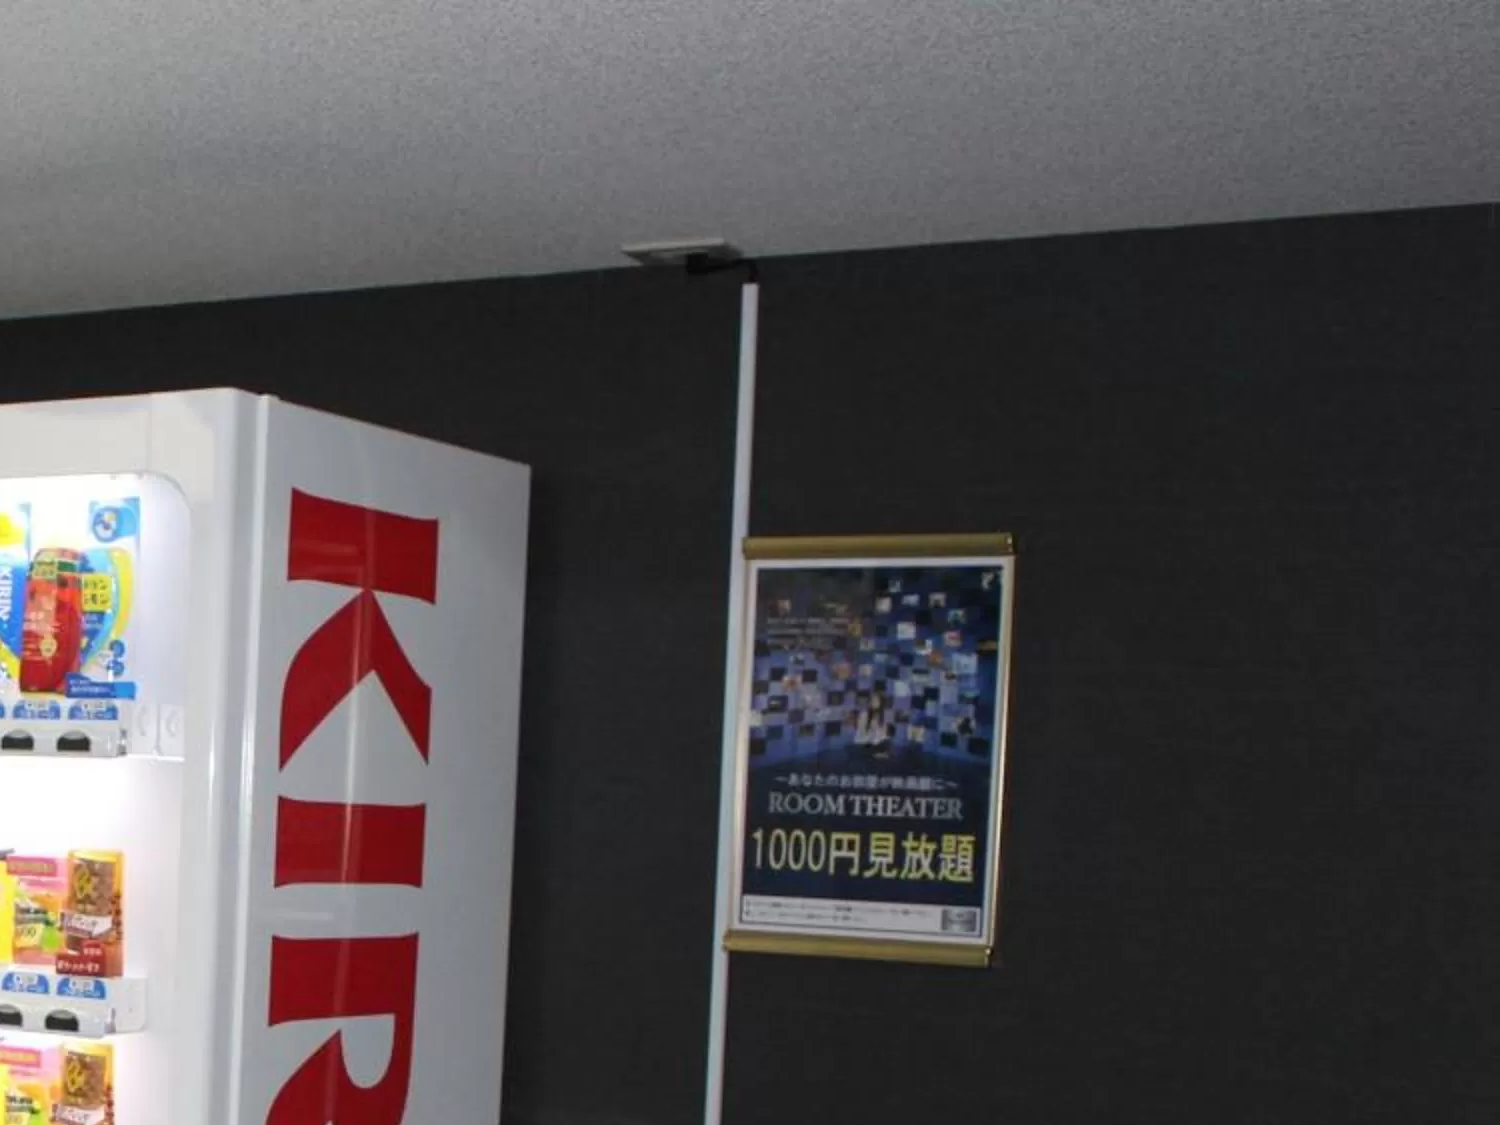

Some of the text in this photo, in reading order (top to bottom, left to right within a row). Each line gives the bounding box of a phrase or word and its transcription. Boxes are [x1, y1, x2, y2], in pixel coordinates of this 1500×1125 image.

[768, 791, 964, 820] ROOM THEATER
[751, 826, 977, 884] 1000円見放題
